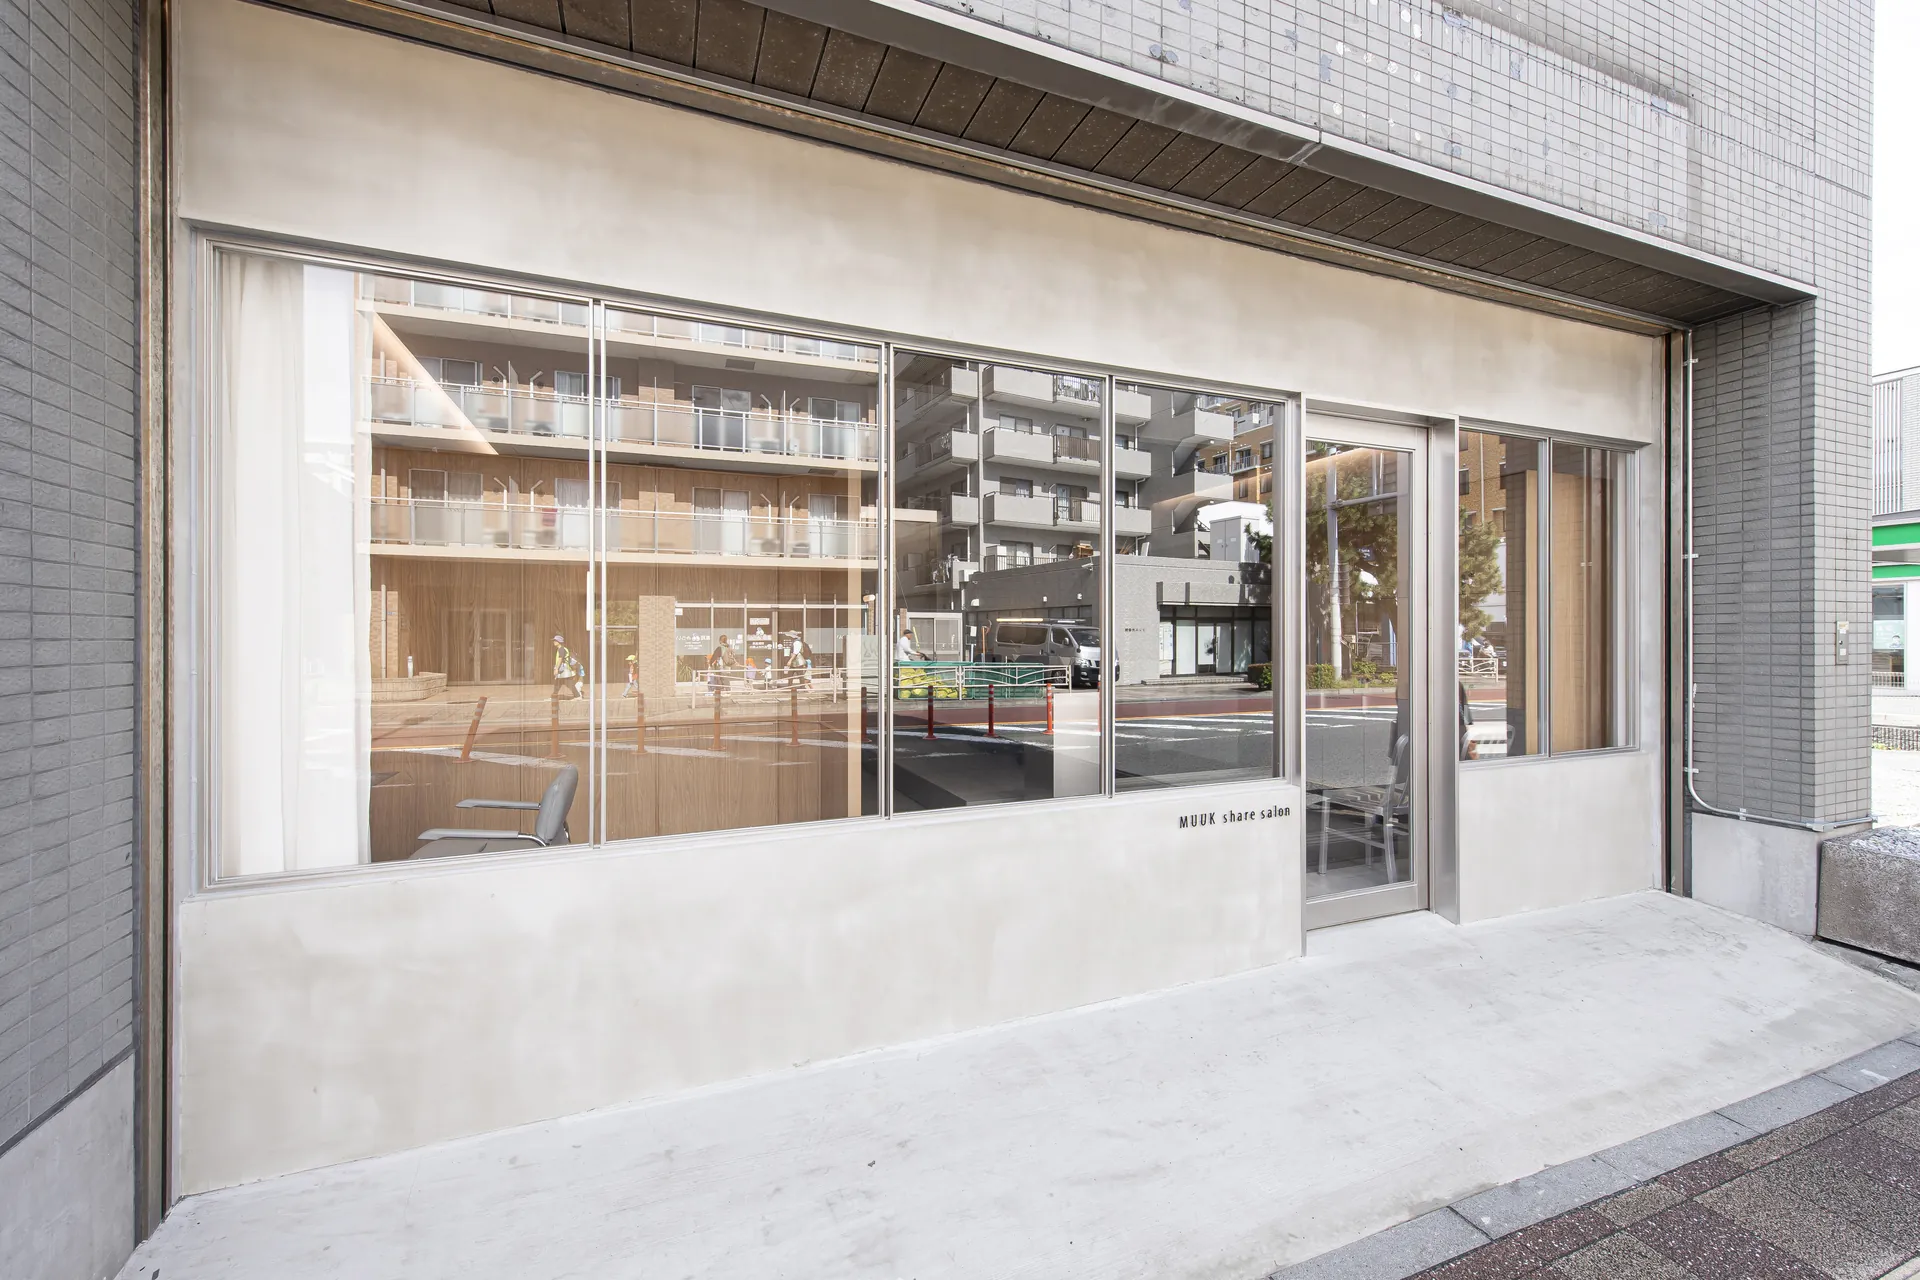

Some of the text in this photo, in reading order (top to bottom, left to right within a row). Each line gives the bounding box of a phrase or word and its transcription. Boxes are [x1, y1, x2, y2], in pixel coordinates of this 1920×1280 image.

[1179, 805, 1291, 828] MUUK share salon
